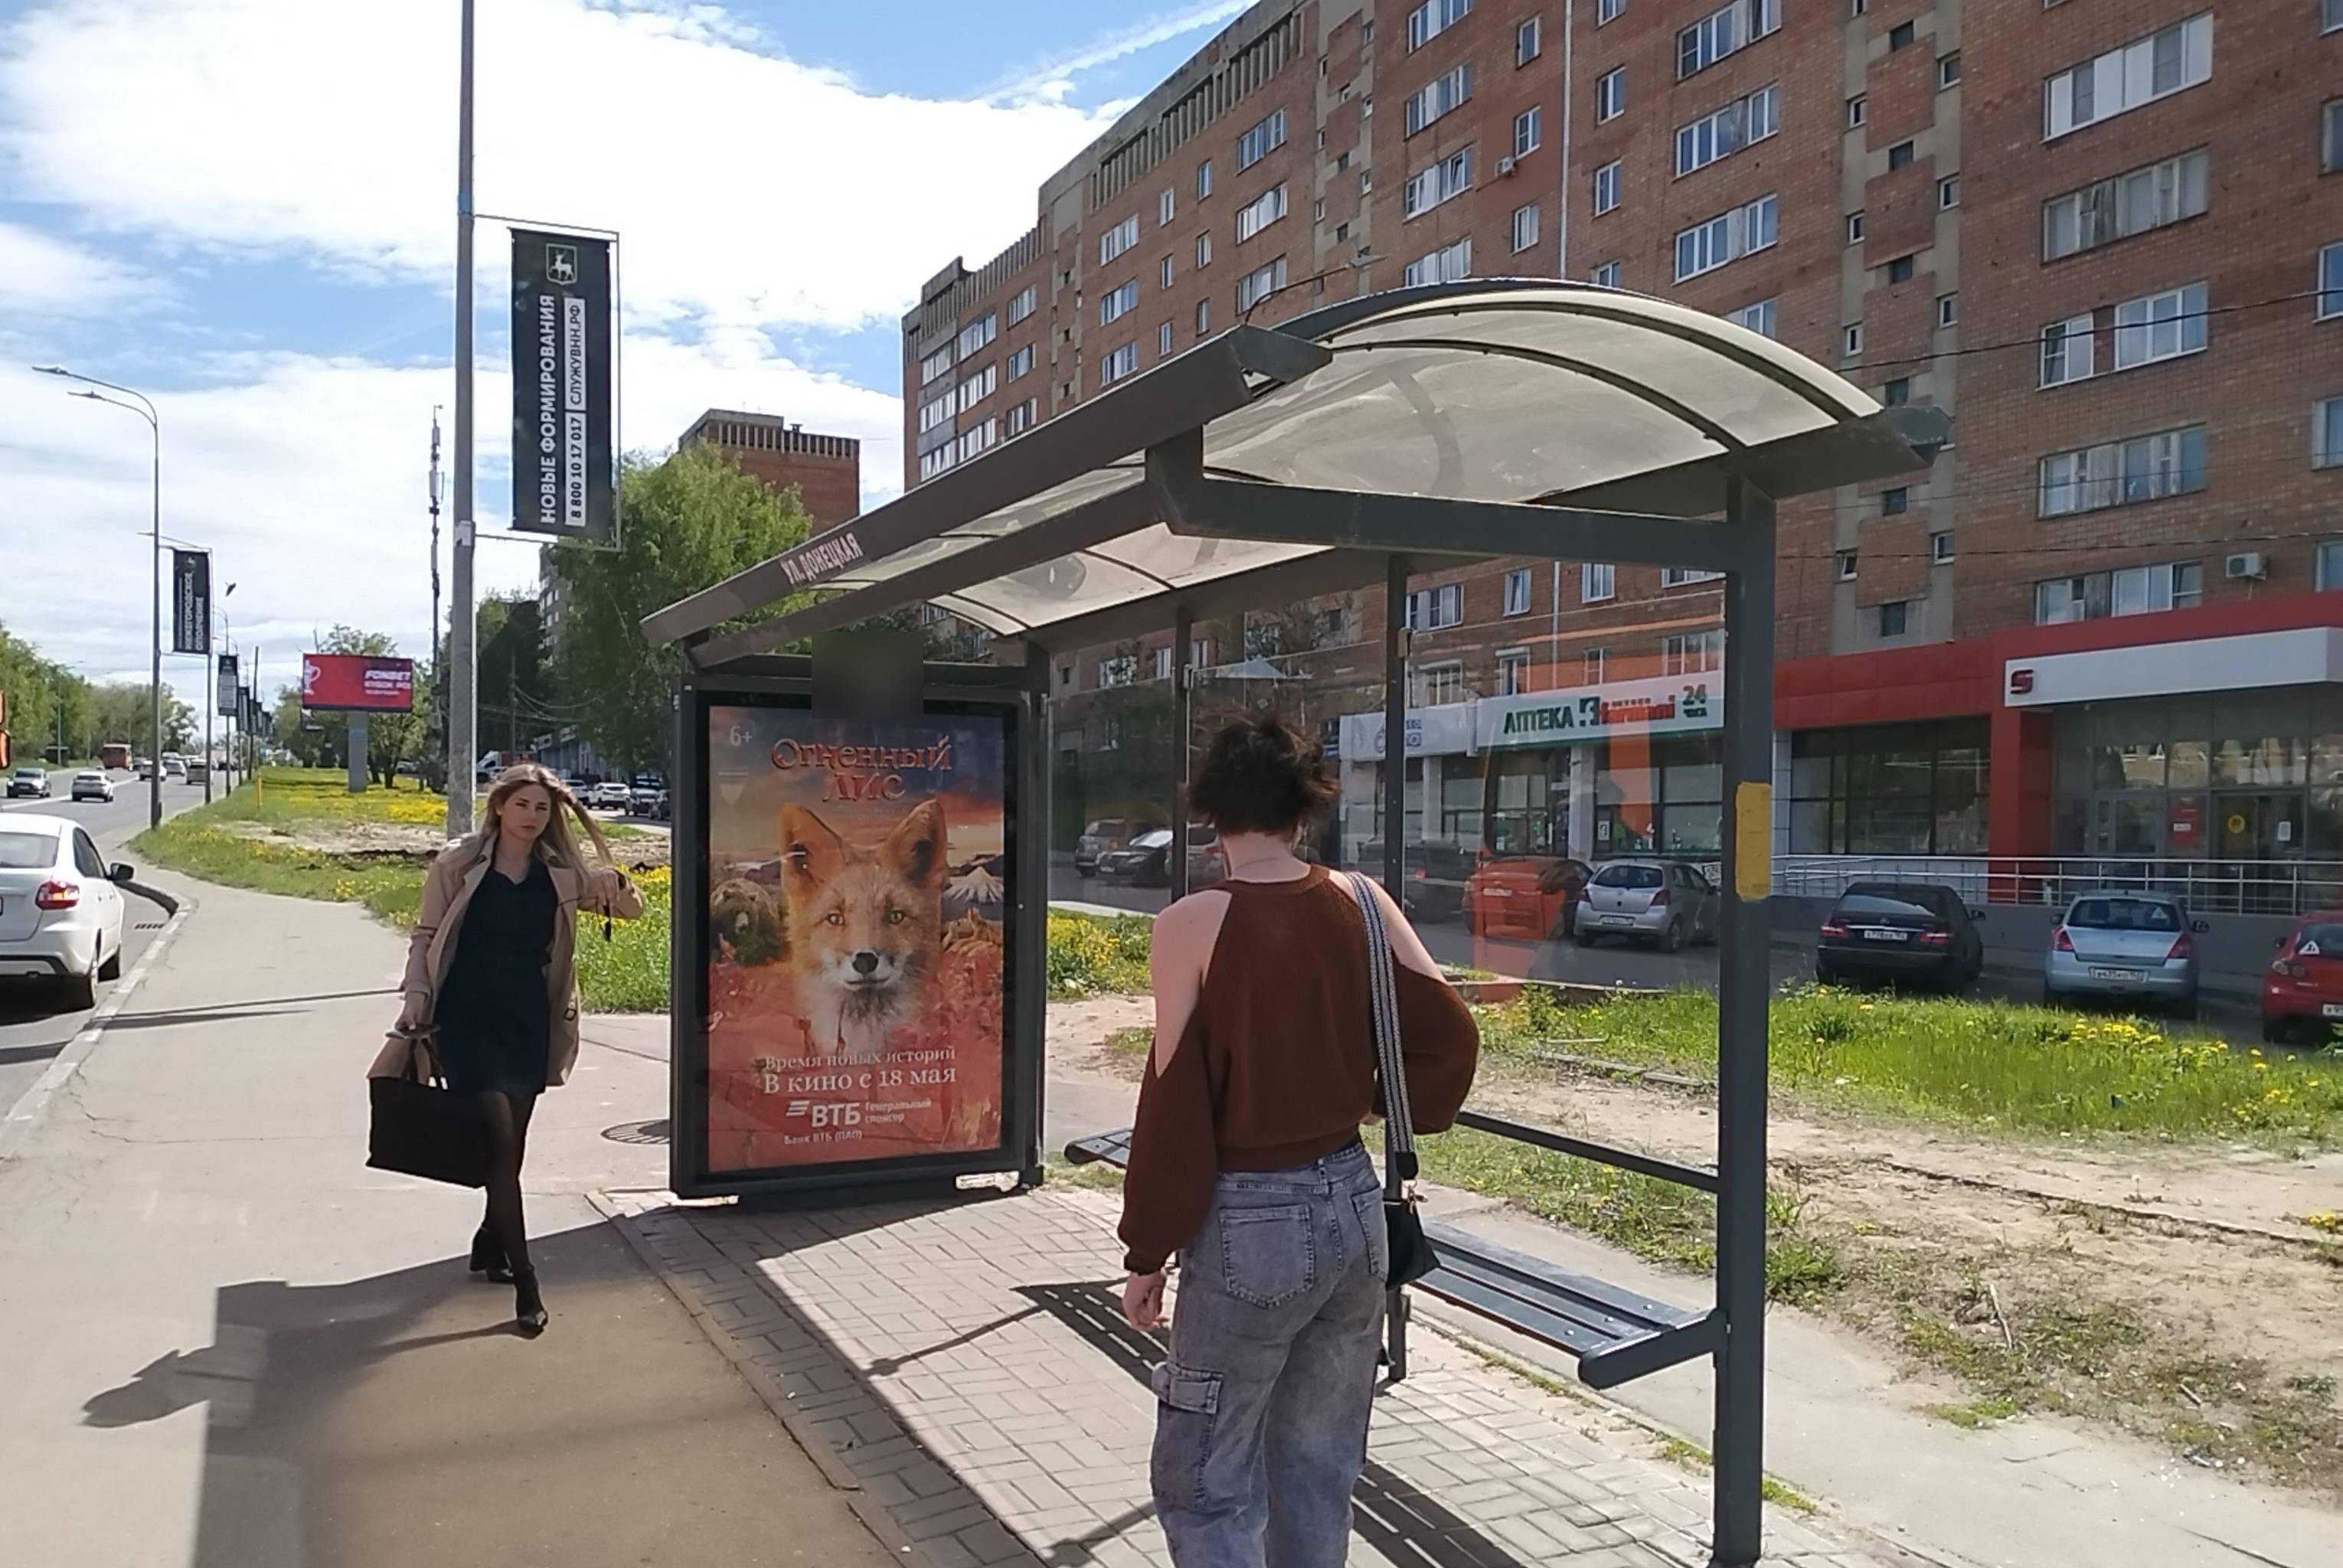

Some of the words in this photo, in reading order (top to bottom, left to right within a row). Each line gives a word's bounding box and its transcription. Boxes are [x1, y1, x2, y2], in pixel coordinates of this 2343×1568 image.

[570, 305, 582, 405] СЛУЖУВНН.РФ
[540, 295, 556, 453] ФОРМИРОВАНИЯ
[570, 417, 582, 440] 017
[570, 443, 582, 459] 17
[571, 462, 582, 479] 10
[541, 456, 556, 524] НОВЫЕ
[571, 482, 582, 507] 800
[571, 510, 582, 518] 8
[799, 532, 864, 581] ДОНЕЦКАЯ
[1682, 684, 1707, 705] 24
[1503, 705, 1574, 734] АПТЕКА
[729, 725, 753, 746] 6+
[765, 1055, 822, 1073] Время
[827, 1054, 881, 1067] новых
[887, 1046, 956, 1066] историй
[763, 1073, 779, 1094] В
[787, 1076, 853, 1093] кино
[859, 1075, 872, 1089] с
[879, 1070, 903, 1088] 18
[910, 1067, 957, 1085] мая
[812, 1102, 861, 1128] ВТБ
[783, 1135, 811, 1145] Банк
[812, 1132, 832, 1142] ВТБ
